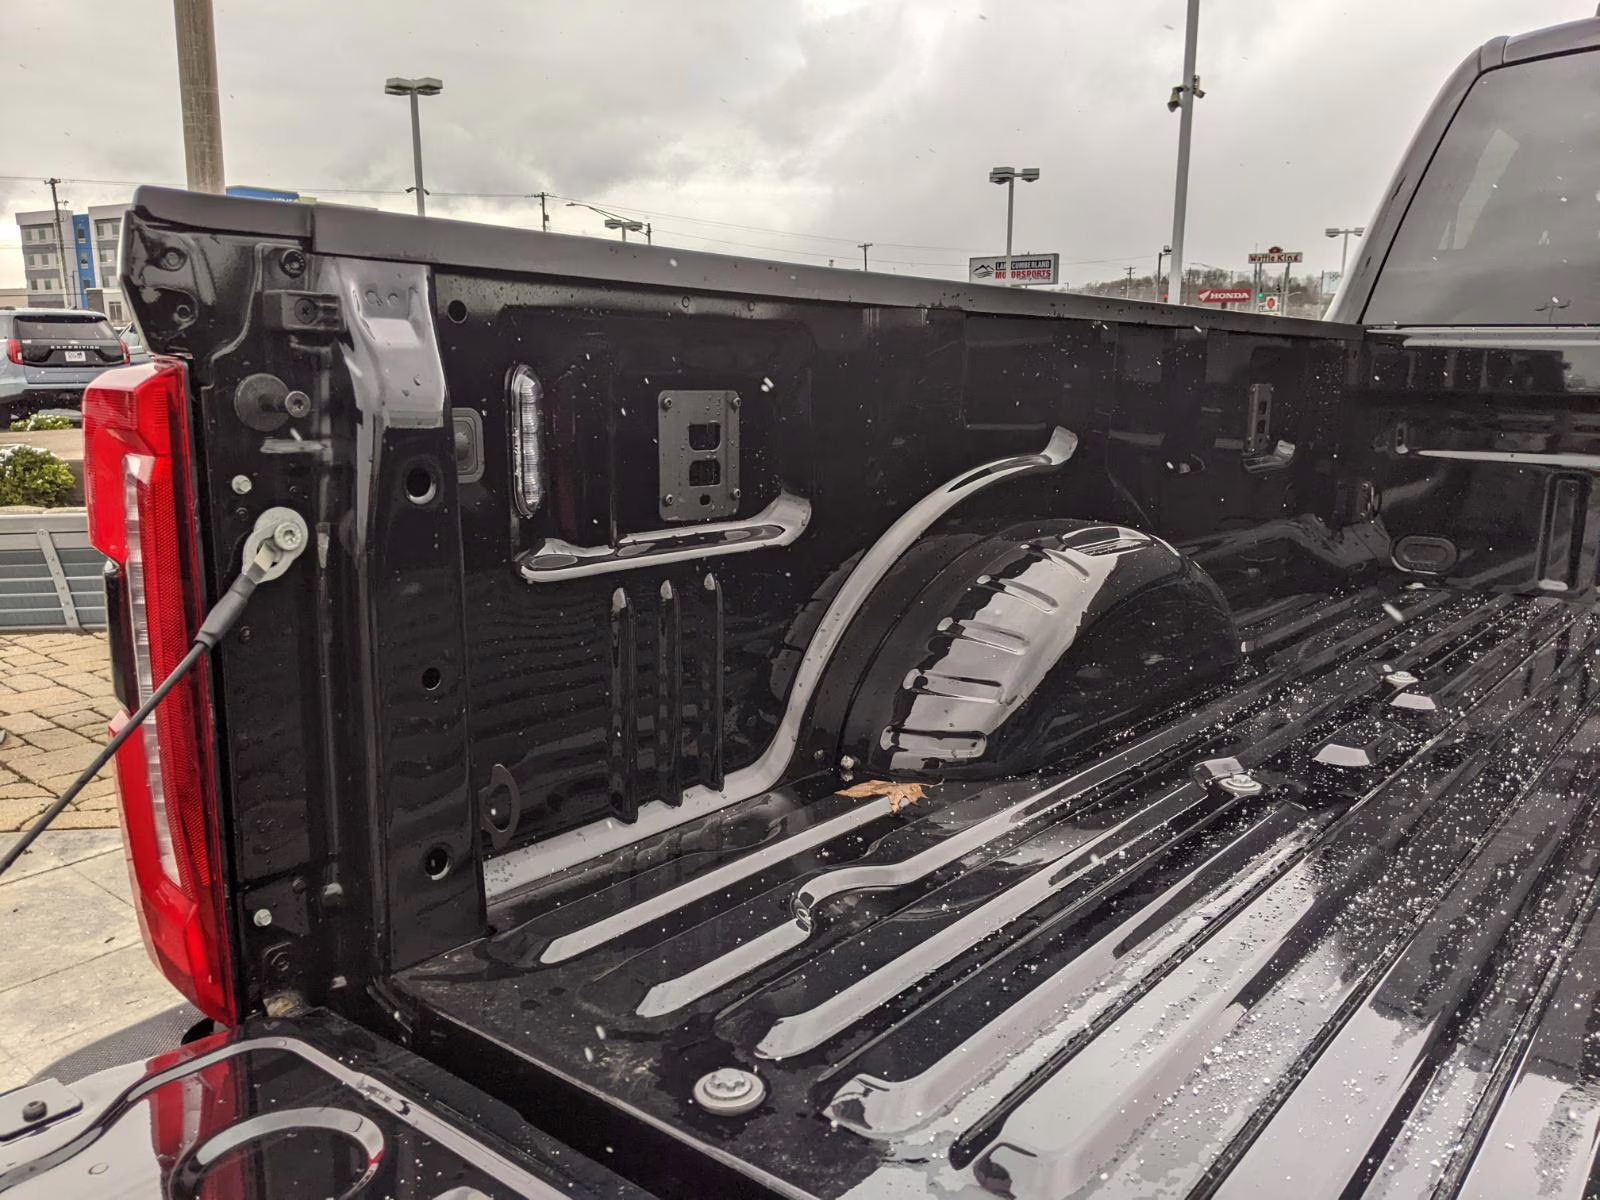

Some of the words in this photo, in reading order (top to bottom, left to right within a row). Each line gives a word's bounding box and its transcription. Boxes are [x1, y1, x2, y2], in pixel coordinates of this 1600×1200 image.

[1250, 254, 1275, 262] Waffle
[1277, 254, 1299, 262] King
[1011, 261, 1050, 269] CUMBERLAND
[995, 270, 1051, 279] MOORSPORTS
